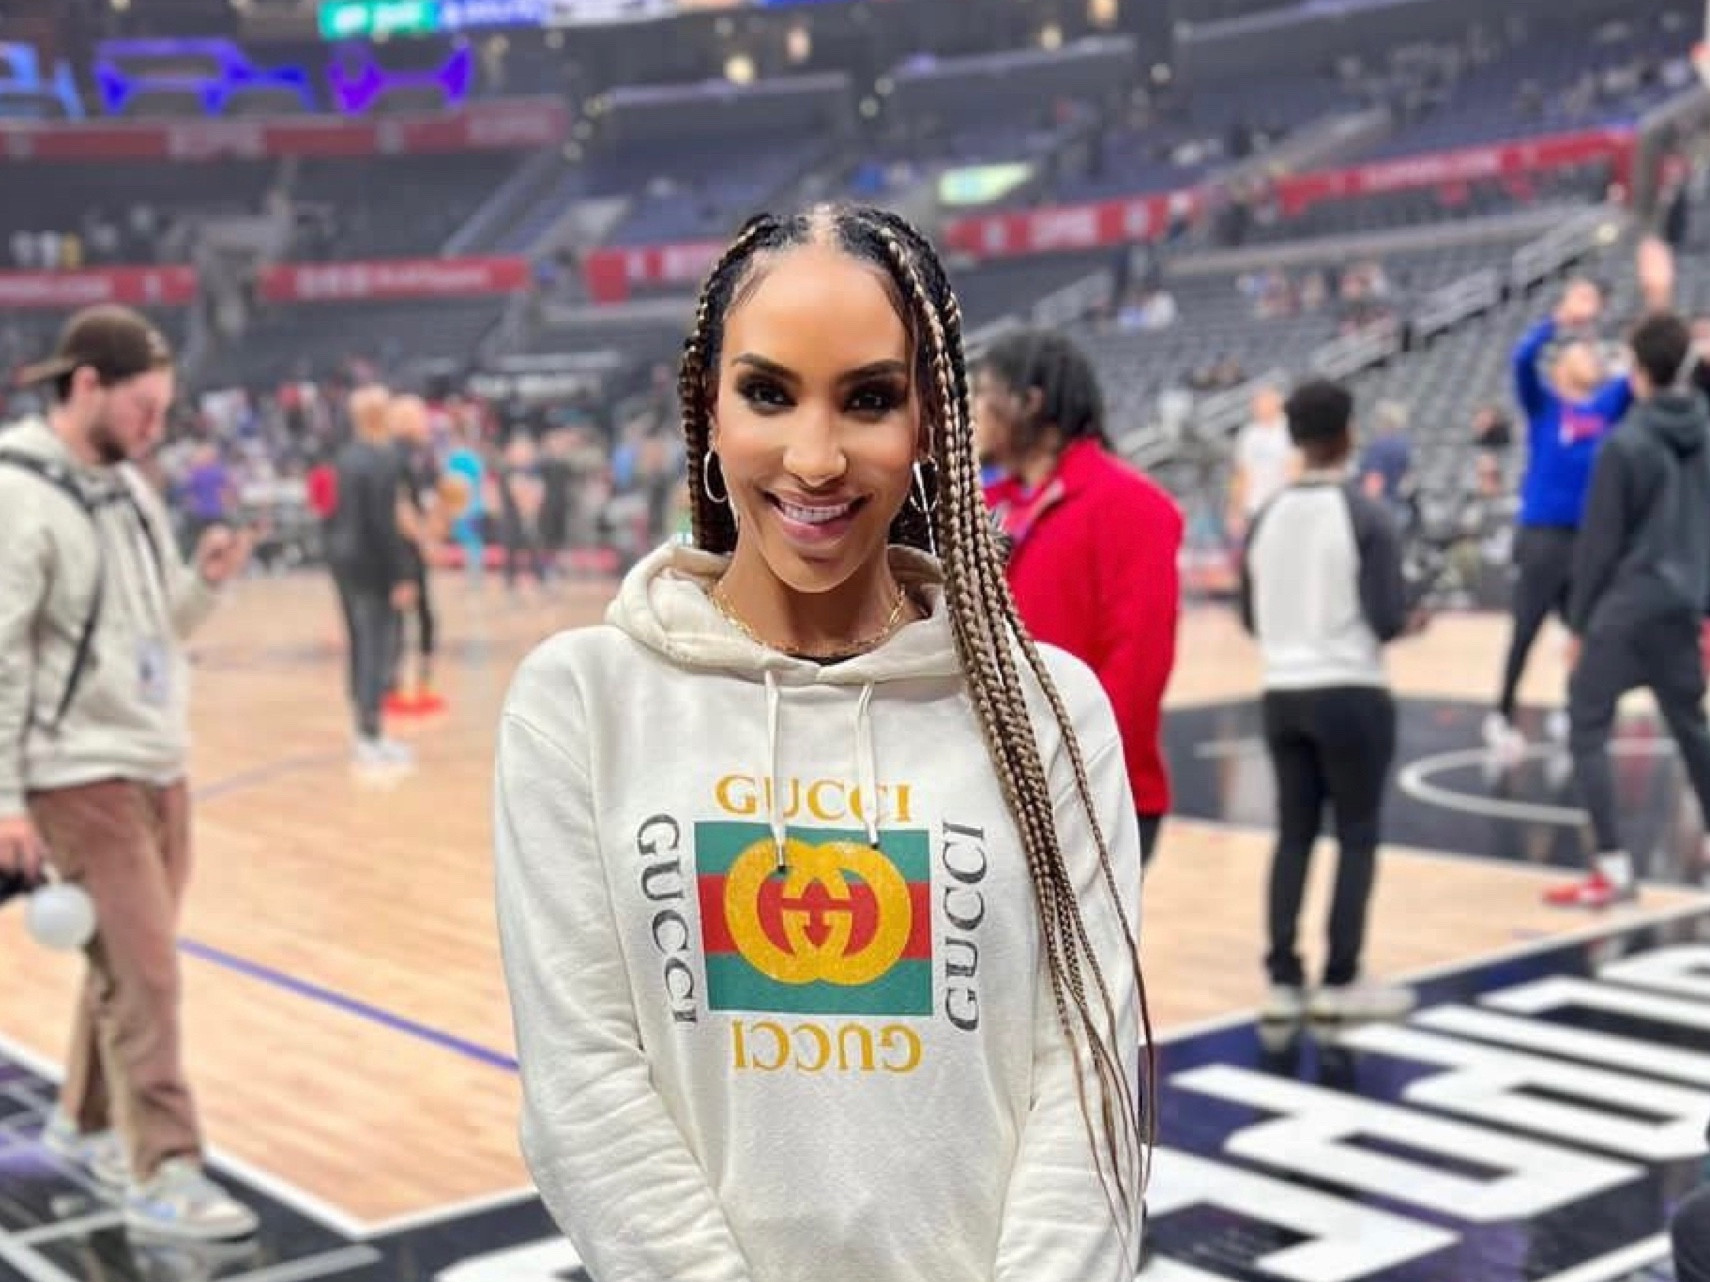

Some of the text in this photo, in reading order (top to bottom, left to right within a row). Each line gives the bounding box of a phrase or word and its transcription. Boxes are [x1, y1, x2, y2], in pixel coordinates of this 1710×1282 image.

[715, 774, 913, 823] GUCCI
[637, 814, 698, 1025] GUCCI
[942, 820, 988, 1032] GUCCI
[731, 1019, 925, 1074] GUCCI
